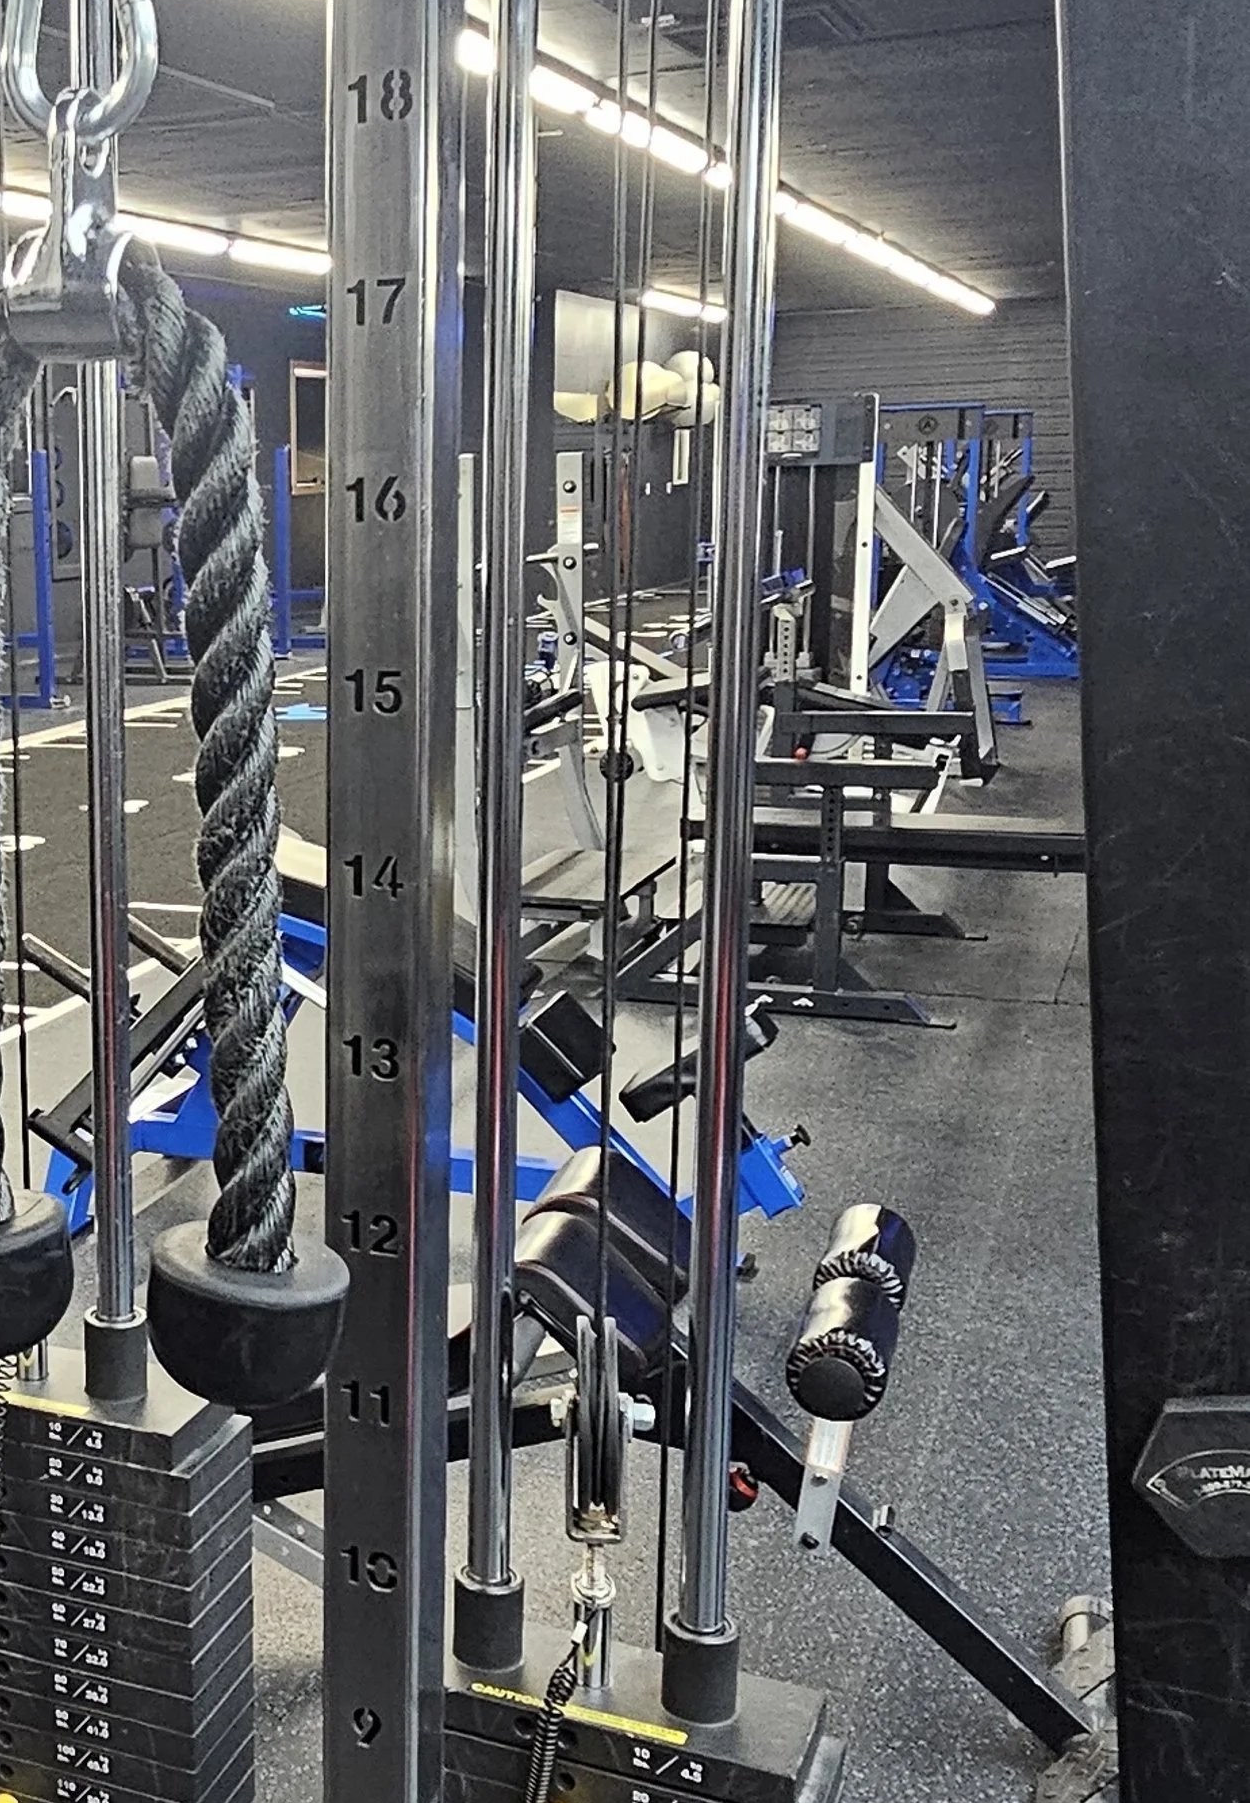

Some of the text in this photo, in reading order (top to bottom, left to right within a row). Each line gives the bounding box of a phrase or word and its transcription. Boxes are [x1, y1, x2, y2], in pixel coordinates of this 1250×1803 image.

[348, 69, 413, 124] 18
[346, 277, 406, 326] 17
[345, 475, 406, 524] 16
[345, 669, 403, 716] 15
[343, 854, 404, 900] 14
[343, 1034, 400, 1082] 13
[341, 1209, 398, 1258] 12
[49, 1422, 61, 1432] 10
[341, 1380, 390, 1428] 11
[340, 1545, 398, 1593] 10
[55, 1638, 67, 1648] 70
[352, 1707, 382, 1749] 9
[634, 1747, 650, 1759] 10
[58, 1779, 76, 1791] 110
